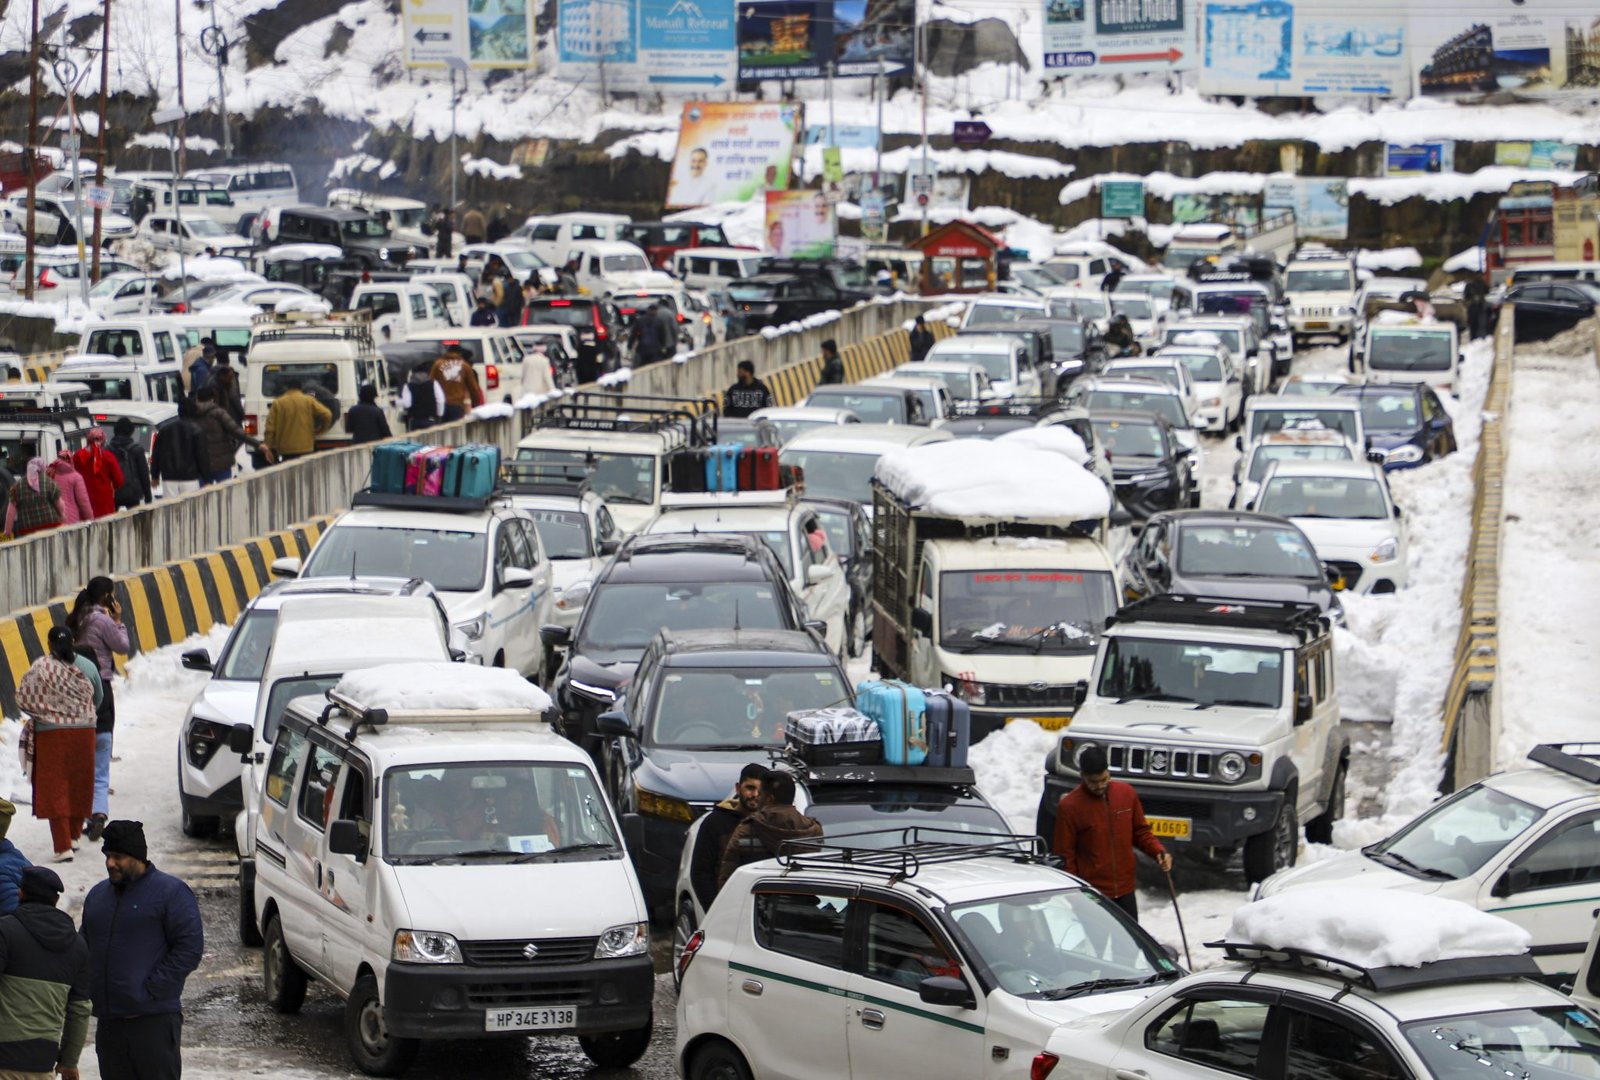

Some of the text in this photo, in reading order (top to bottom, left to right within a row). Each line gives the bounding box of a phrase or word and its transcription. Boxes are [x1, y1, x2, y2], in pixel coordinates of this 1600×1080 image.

[497, 1010, 574, 1027] HP 34E 3138
